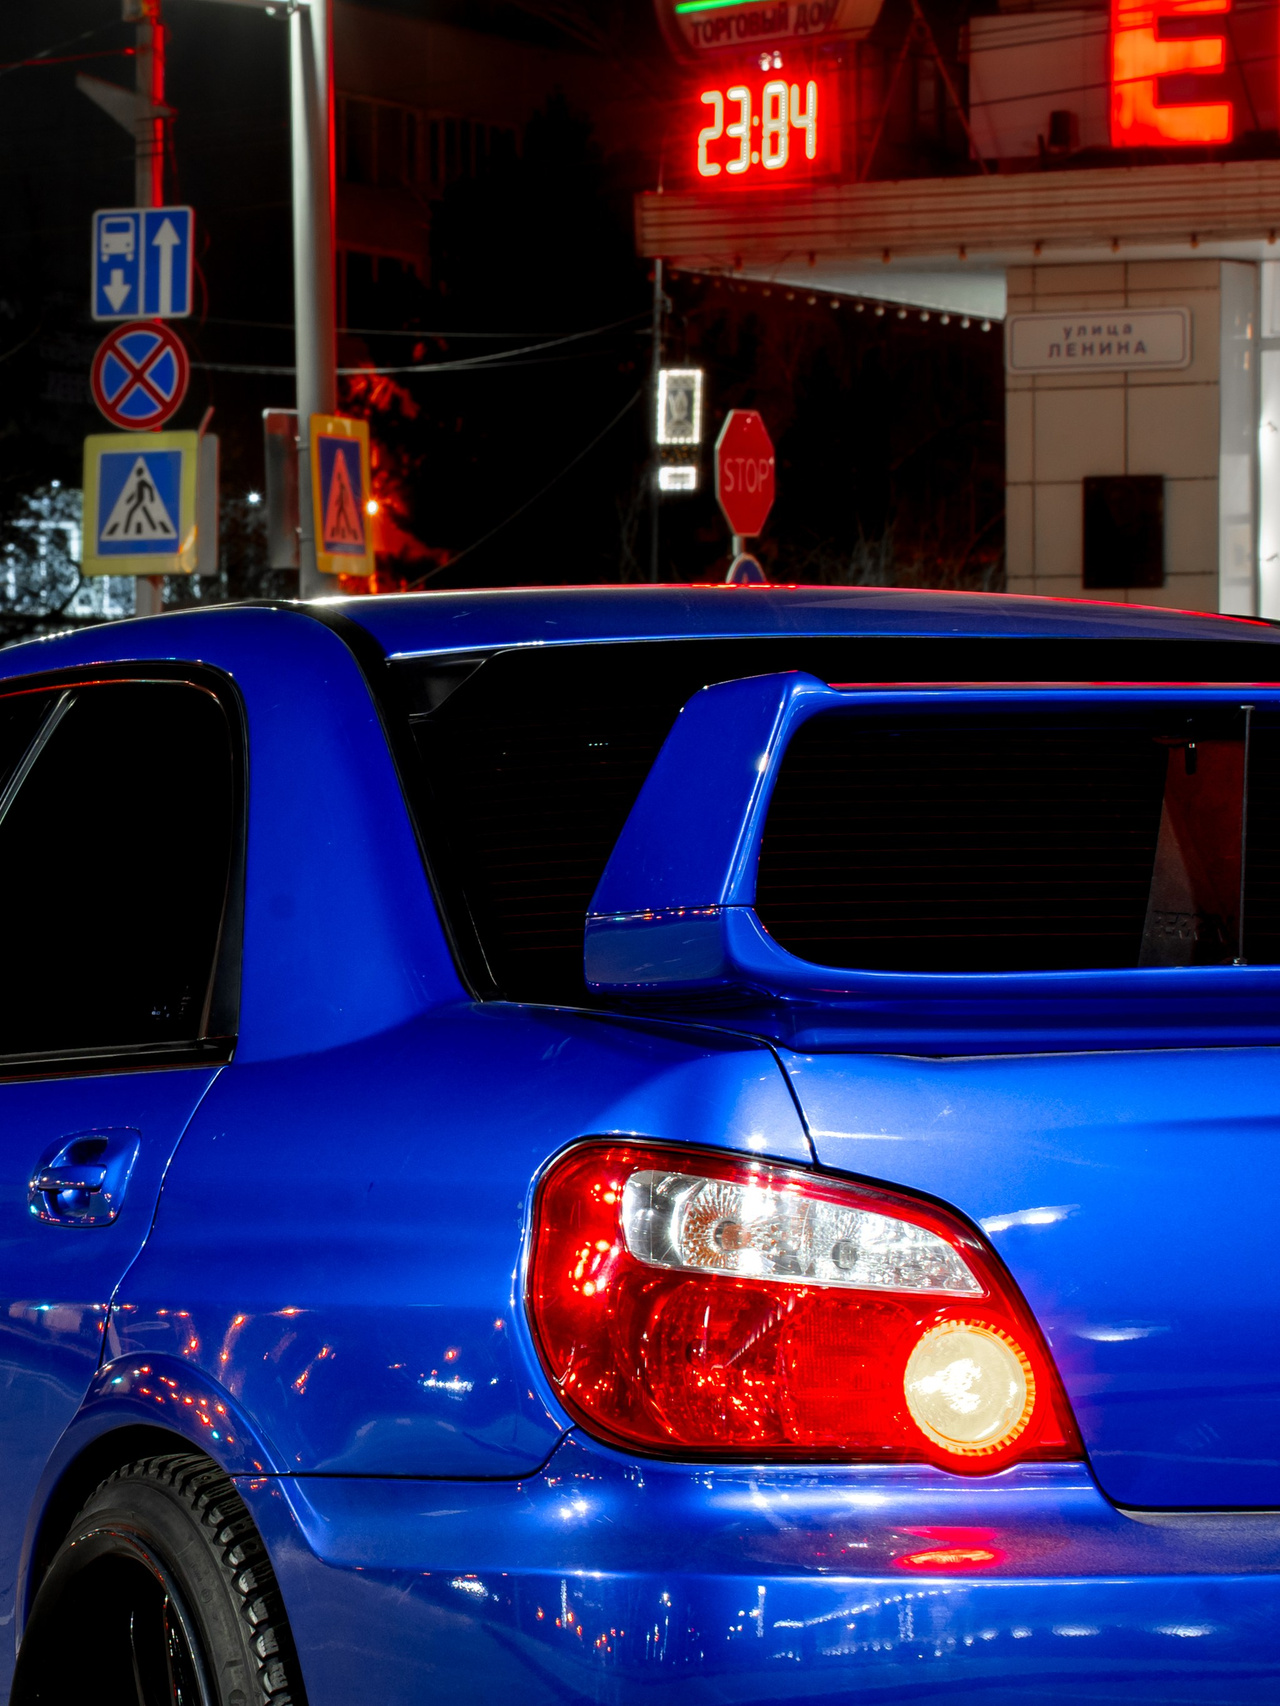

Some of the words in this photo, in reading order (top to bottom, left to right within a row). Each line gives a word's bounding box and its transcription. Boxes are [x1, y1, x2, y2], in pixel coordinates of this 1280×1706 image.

[690, 2, 789, 45] ТОРГОВЫЙ
[1063, 323, 1133, 340] улица
[1048, 340, 1147, 358] ЛЕНИНА
[724, 457, 770, 493] STOP
